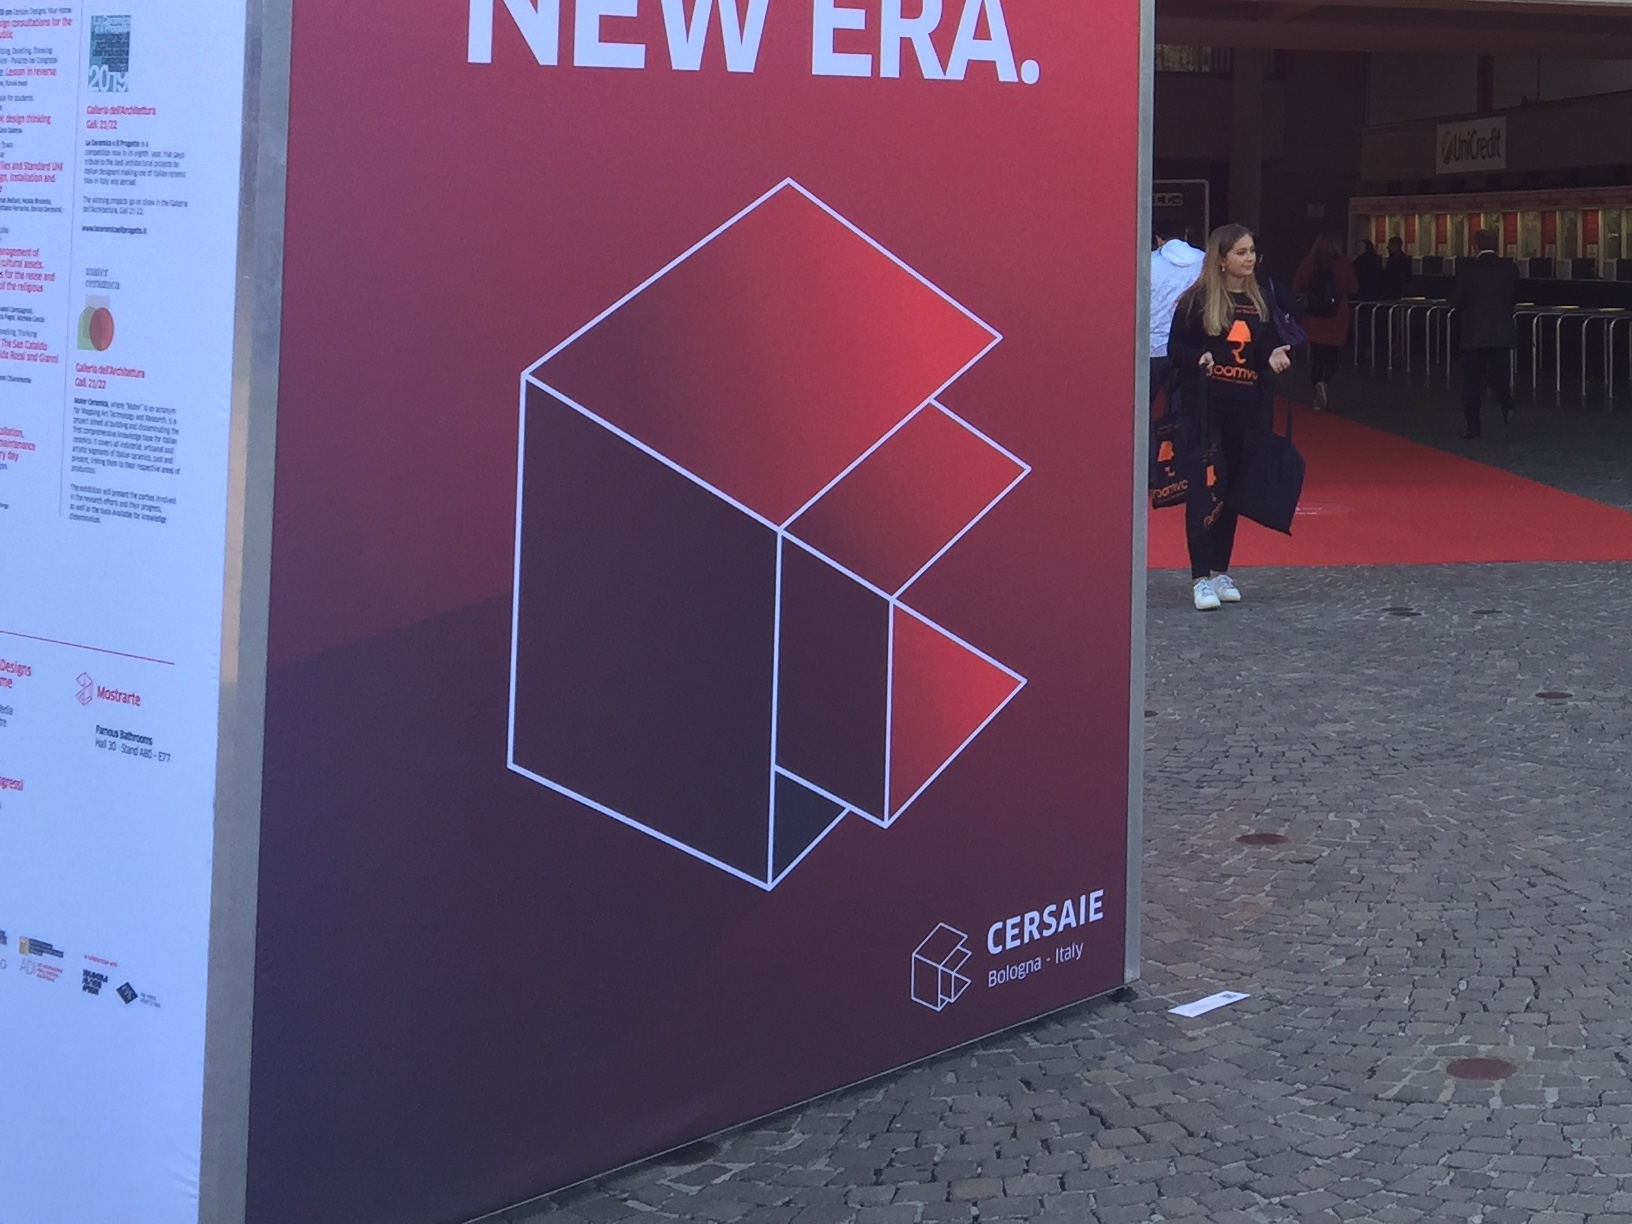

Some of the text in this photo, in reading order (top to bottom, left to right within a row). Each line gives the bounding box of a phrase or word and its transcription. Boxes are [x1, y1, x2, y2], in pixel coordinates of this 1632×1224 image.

[88, 65, 129, 92] 2019
[97, 685, 141, 707] Mostrarte
[95, 724, 153, 746] Famous Bathrooms
[95, 737, 107, 750] Hall
[121, 742, 139, 757] Stand
[987, 889, 1104, 955] CERSAIE
[988, 956, 1042, 988] Bologna
[1055, 942, 1084, 965] Italy
